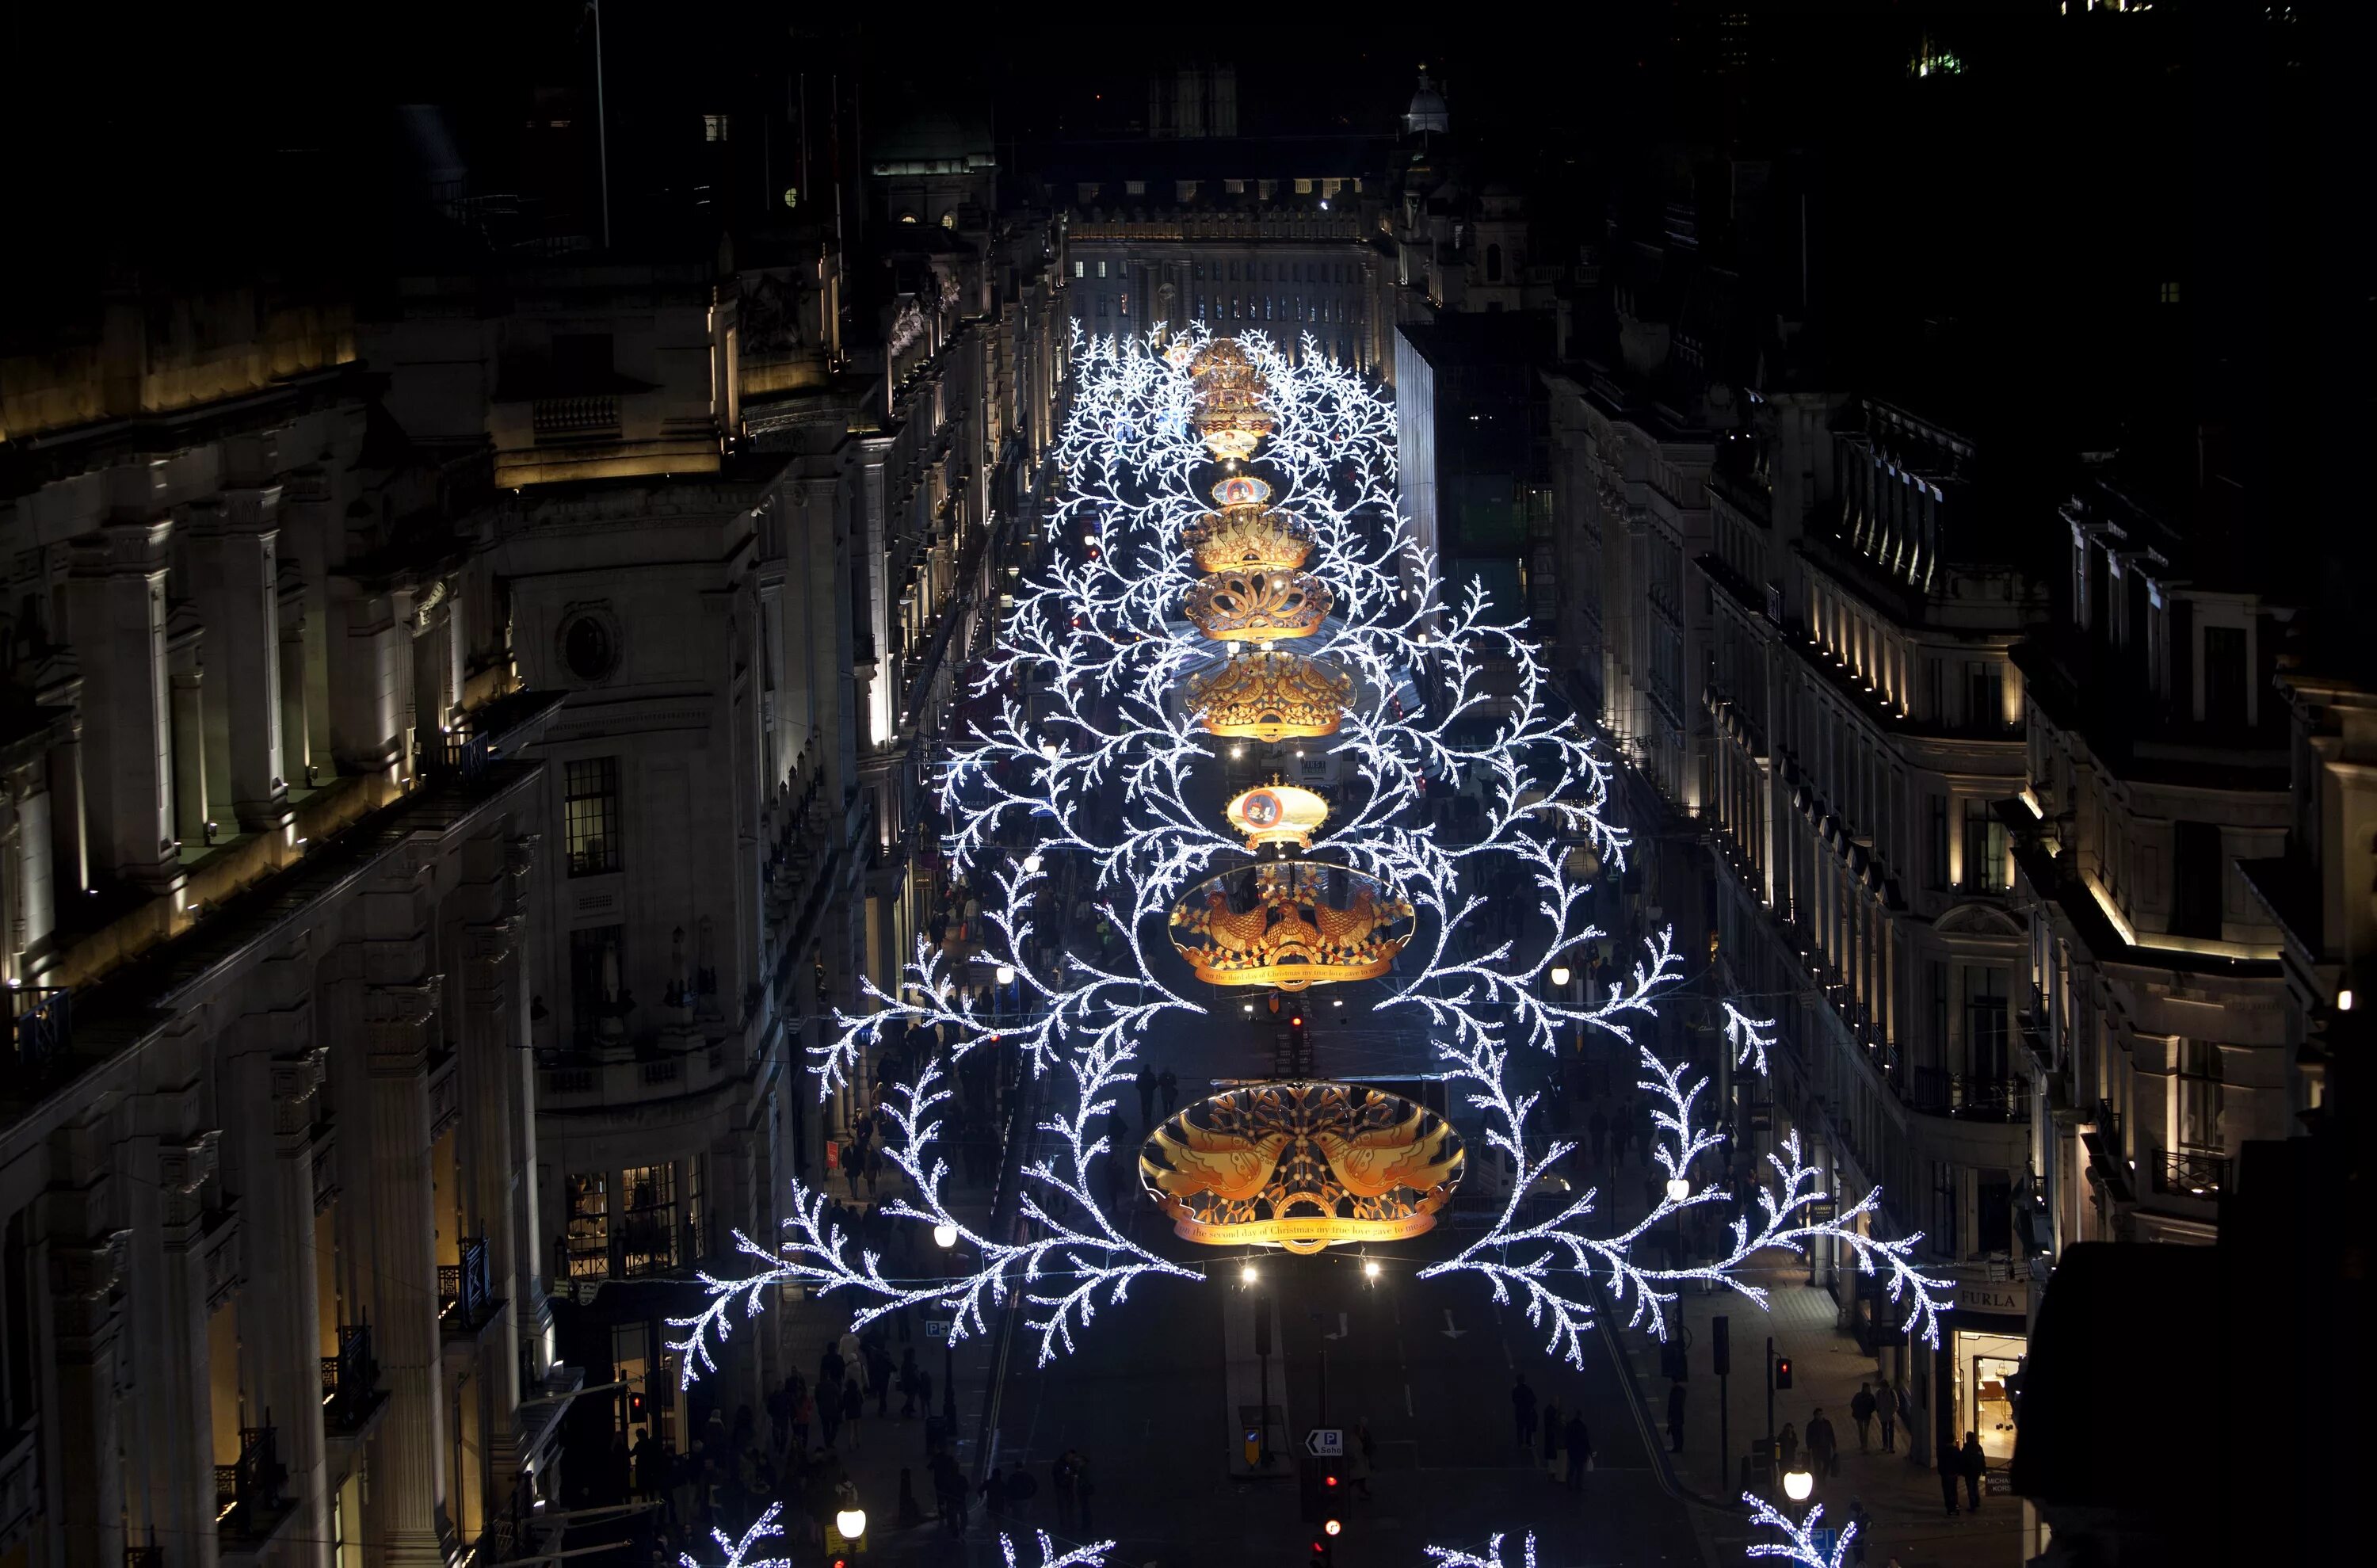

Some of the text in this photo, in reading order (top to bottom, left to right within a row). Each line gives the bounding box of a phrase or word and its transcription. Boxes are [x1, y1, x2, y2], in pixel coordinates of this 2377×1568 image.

[1192, 1227, 1207, 1237] the
[1209, 1230, 1238, 1238] second
[1242, 1229, 1256, 1238] day
[1260, 1226, 1268, 1234] of
[1271, 1226, 1314, 1234] Christmas
[1317, 1227, 1330, 1236] my
[1353, 1225, 1370, 1234] love
[1961, 1290, 2016, 1307] FURLA
[929, 1324, 937, 1334] P
[1326, 1433, 1334, 1444] P
